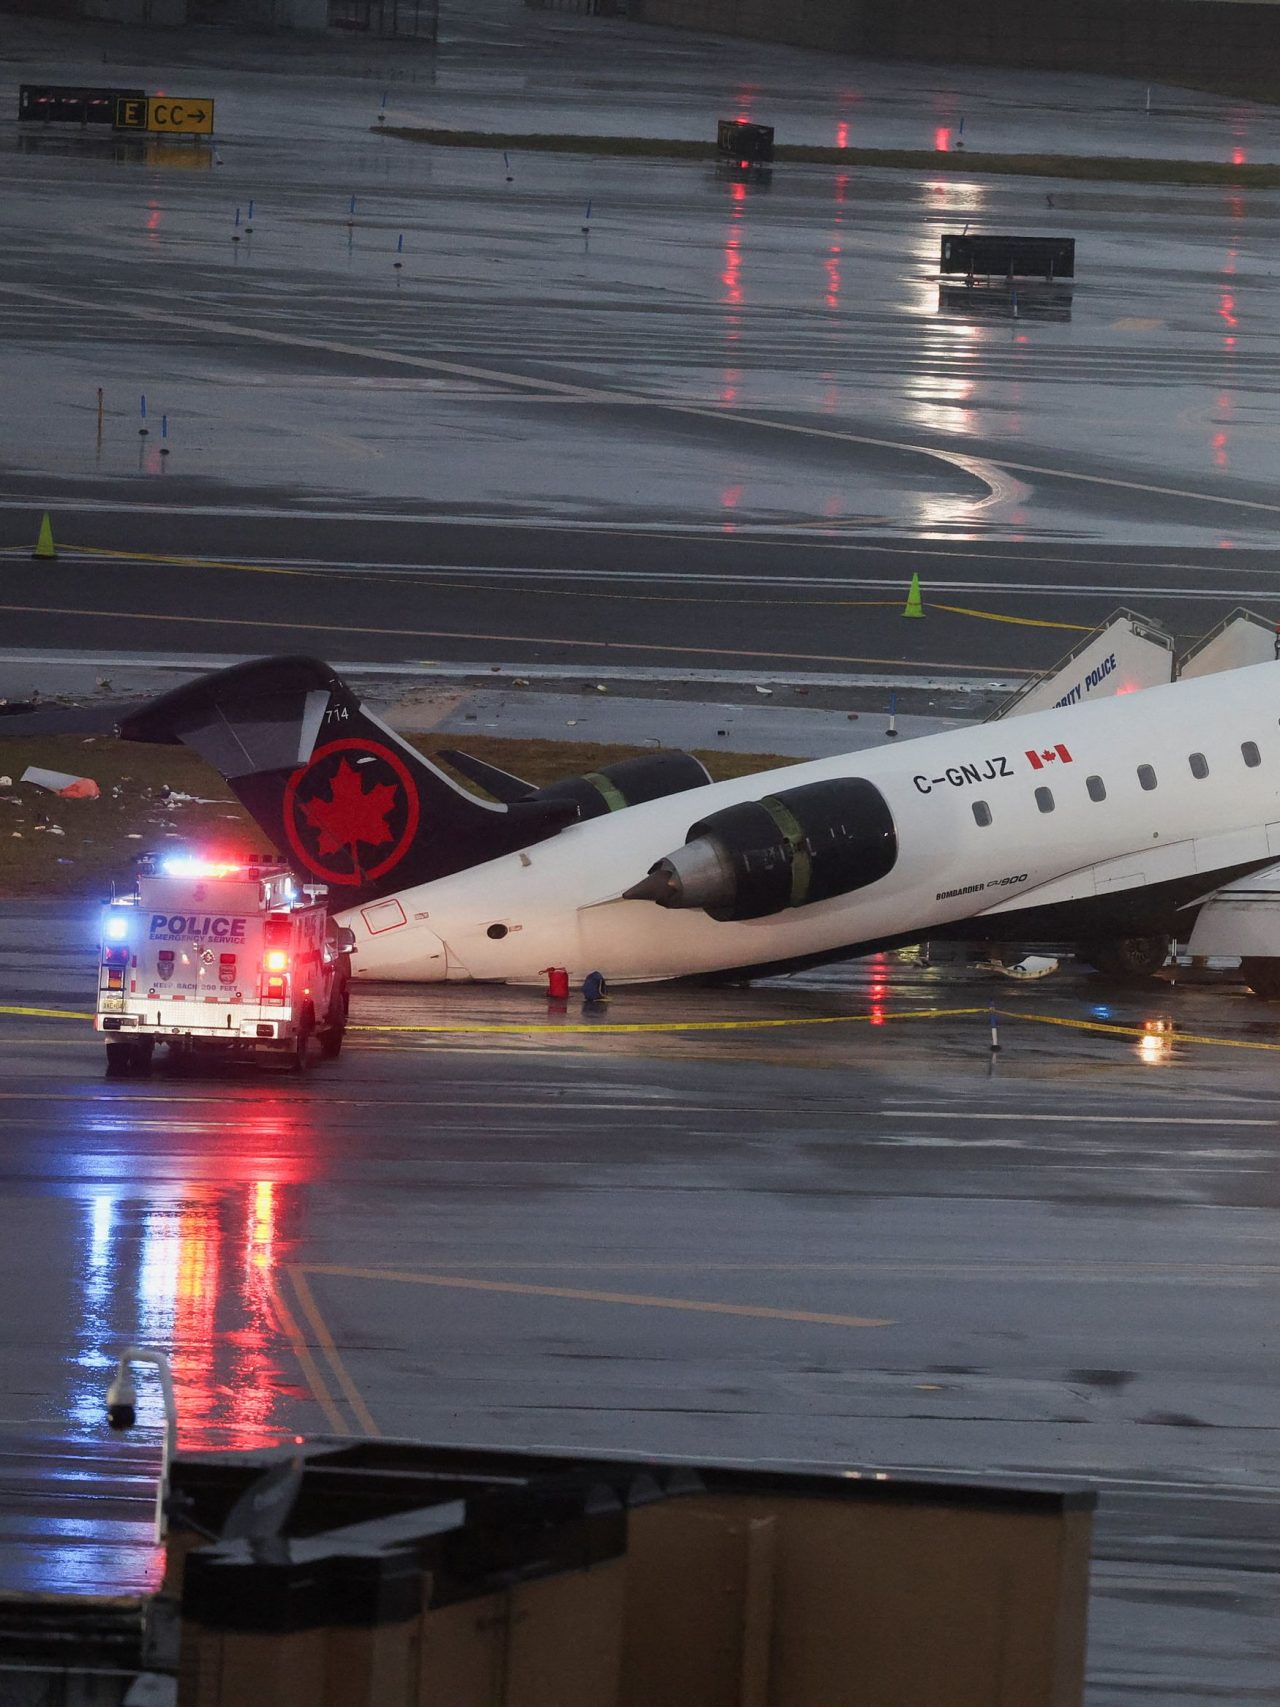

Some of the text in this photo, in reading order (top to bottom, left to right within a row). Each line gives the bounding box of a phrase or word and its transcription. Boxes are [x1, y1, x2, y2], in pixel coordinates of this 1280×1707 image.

[125, 103, 184, 125] E CC
[1085, 653, 1117, 692] POLICE
[326, 707, 349, 723] 714
[913, 757, 1014, 794] C-GNJZ
[936, 883, 984, 900] BOMBARDIER
[149, 915, 246, 936] POLICE
[149, 933, 245, 944] EMERGENCY SERVICE
